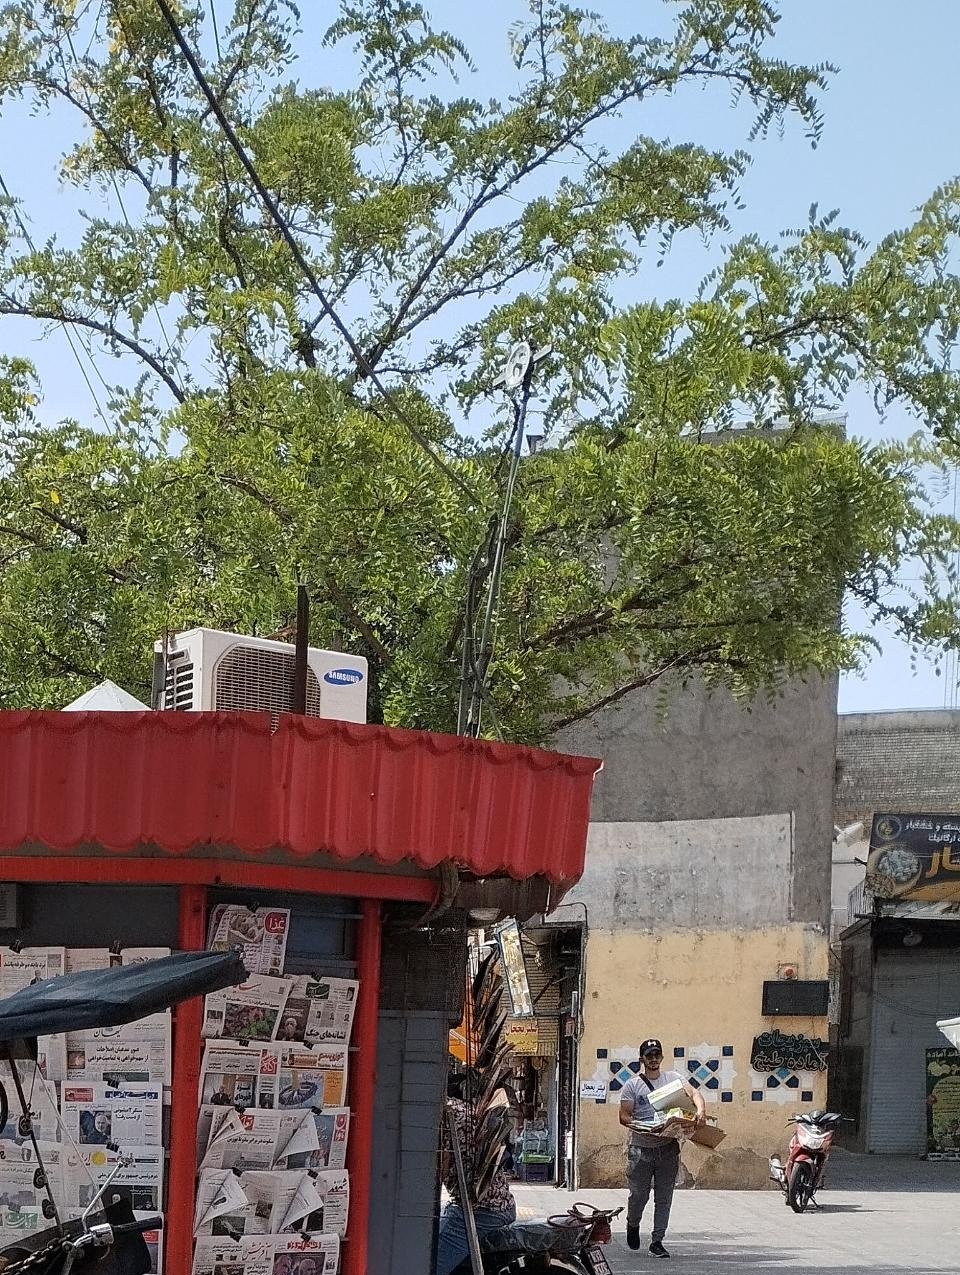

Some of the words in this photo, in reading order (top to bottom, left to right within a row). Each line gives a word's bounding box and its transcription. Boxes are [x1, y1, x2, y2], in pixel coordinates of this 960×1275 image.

[328, 670, 360, 683] SAMSUNG
[93, 1024, 125, 1037] کیهان
[758, 1029, 821, 1053] سبزیجات
[753, 1050, 785, 1072] طبخ
[786, 1052, 829, 1072] آماده
